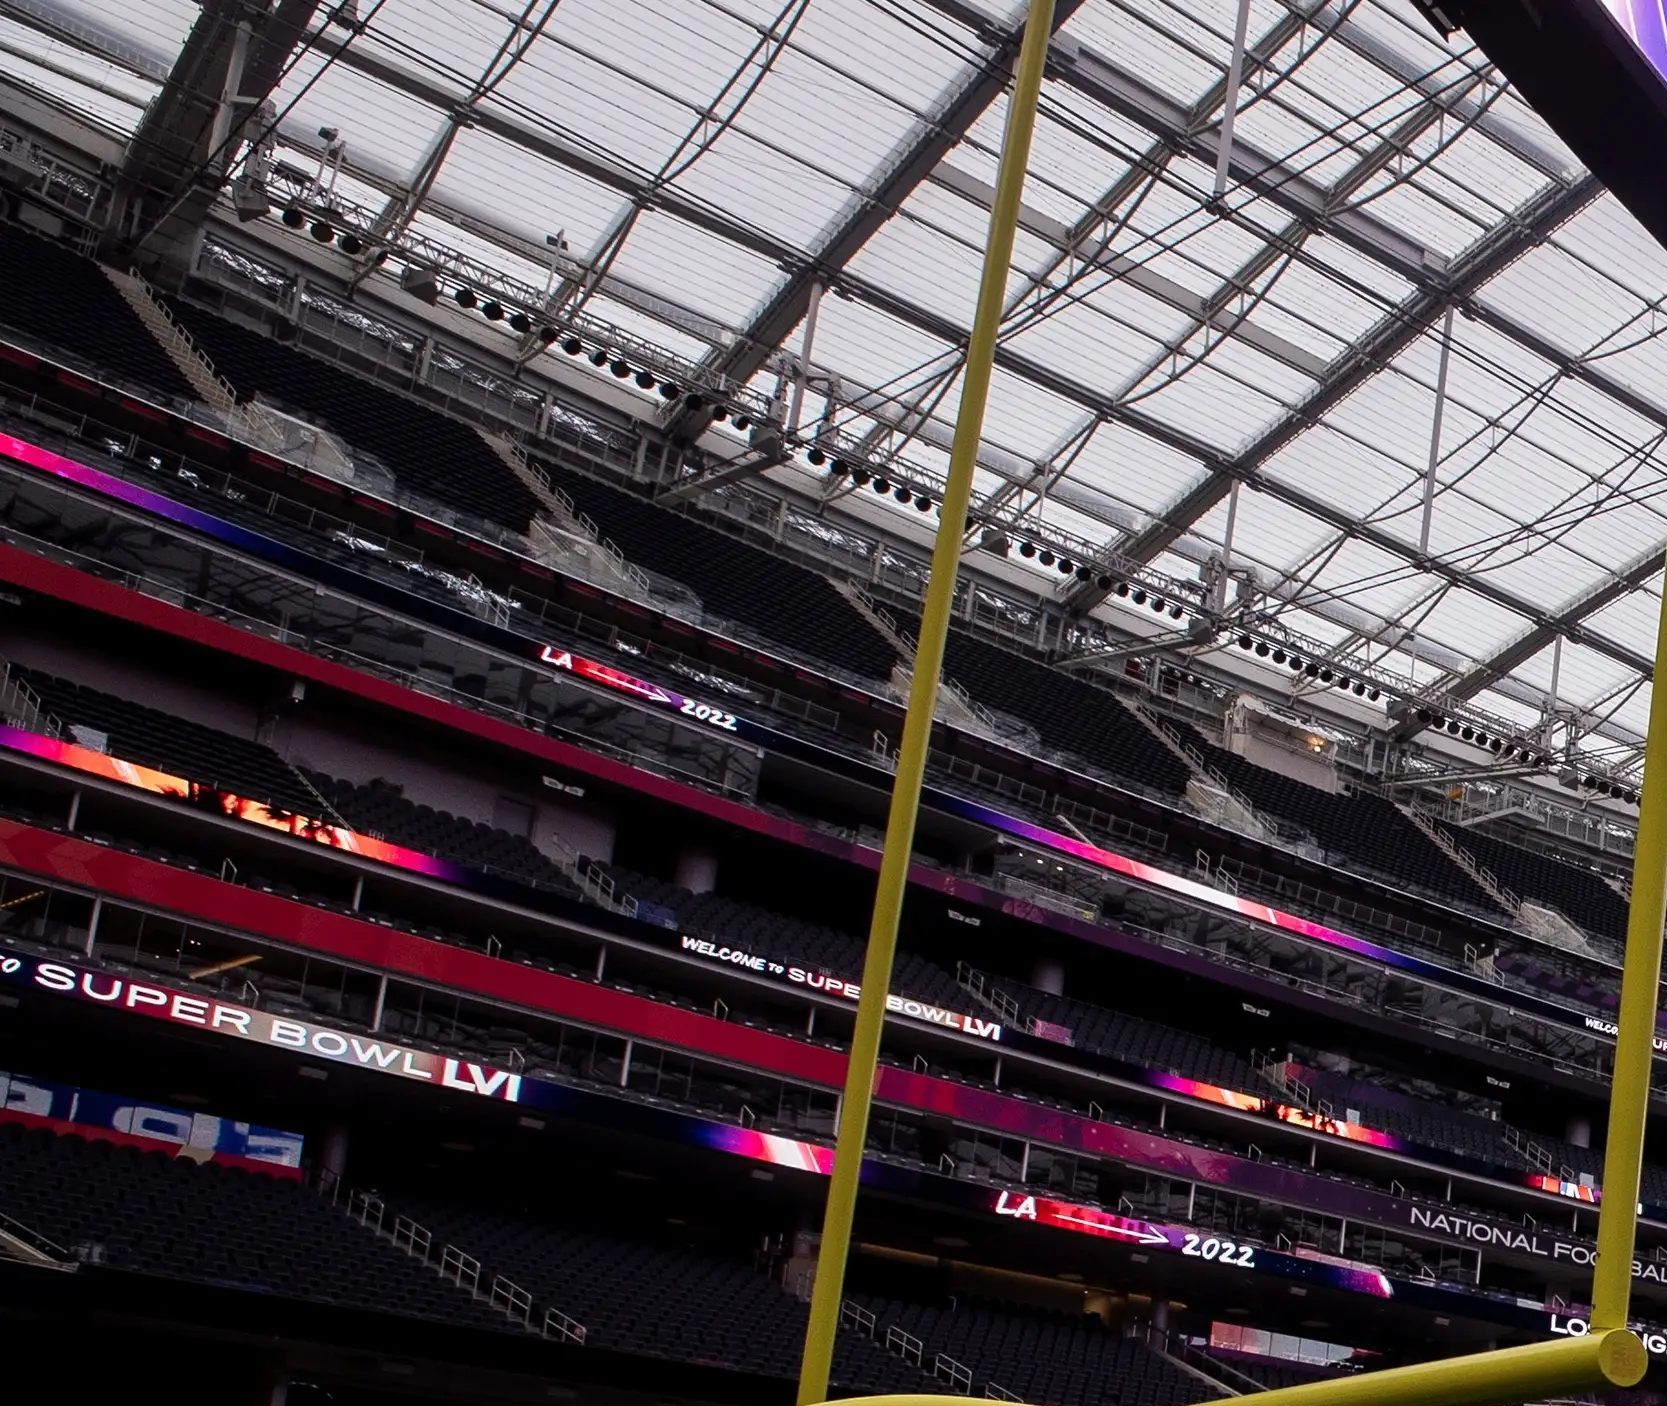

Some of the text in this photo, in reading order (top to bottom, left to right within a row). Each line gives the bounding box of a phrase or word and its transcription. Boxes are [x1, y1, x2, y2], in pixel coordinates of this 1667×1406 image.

[541, 644, 738, 731] LA 2022
[681, 934, 766, 973] WELCOME
[788, 966, 862, 1000] SUPE
[886, 994, 961, 1028] BOWL
[961, 1015, 1002, 1042] LVI
[1585, 1016, 1620, 1037] WELCO
[34, 962, 251, 1035] SUPER
[269, 1019, 433, 1079] BOWL
[441, 1058, 521, 1101] LVI
[996, 1190, 1256, 1269] LA 2022
[1410, 1207, 1548, 1257] NATIONAL
[1551, 1314, 1592, 1338] LO
